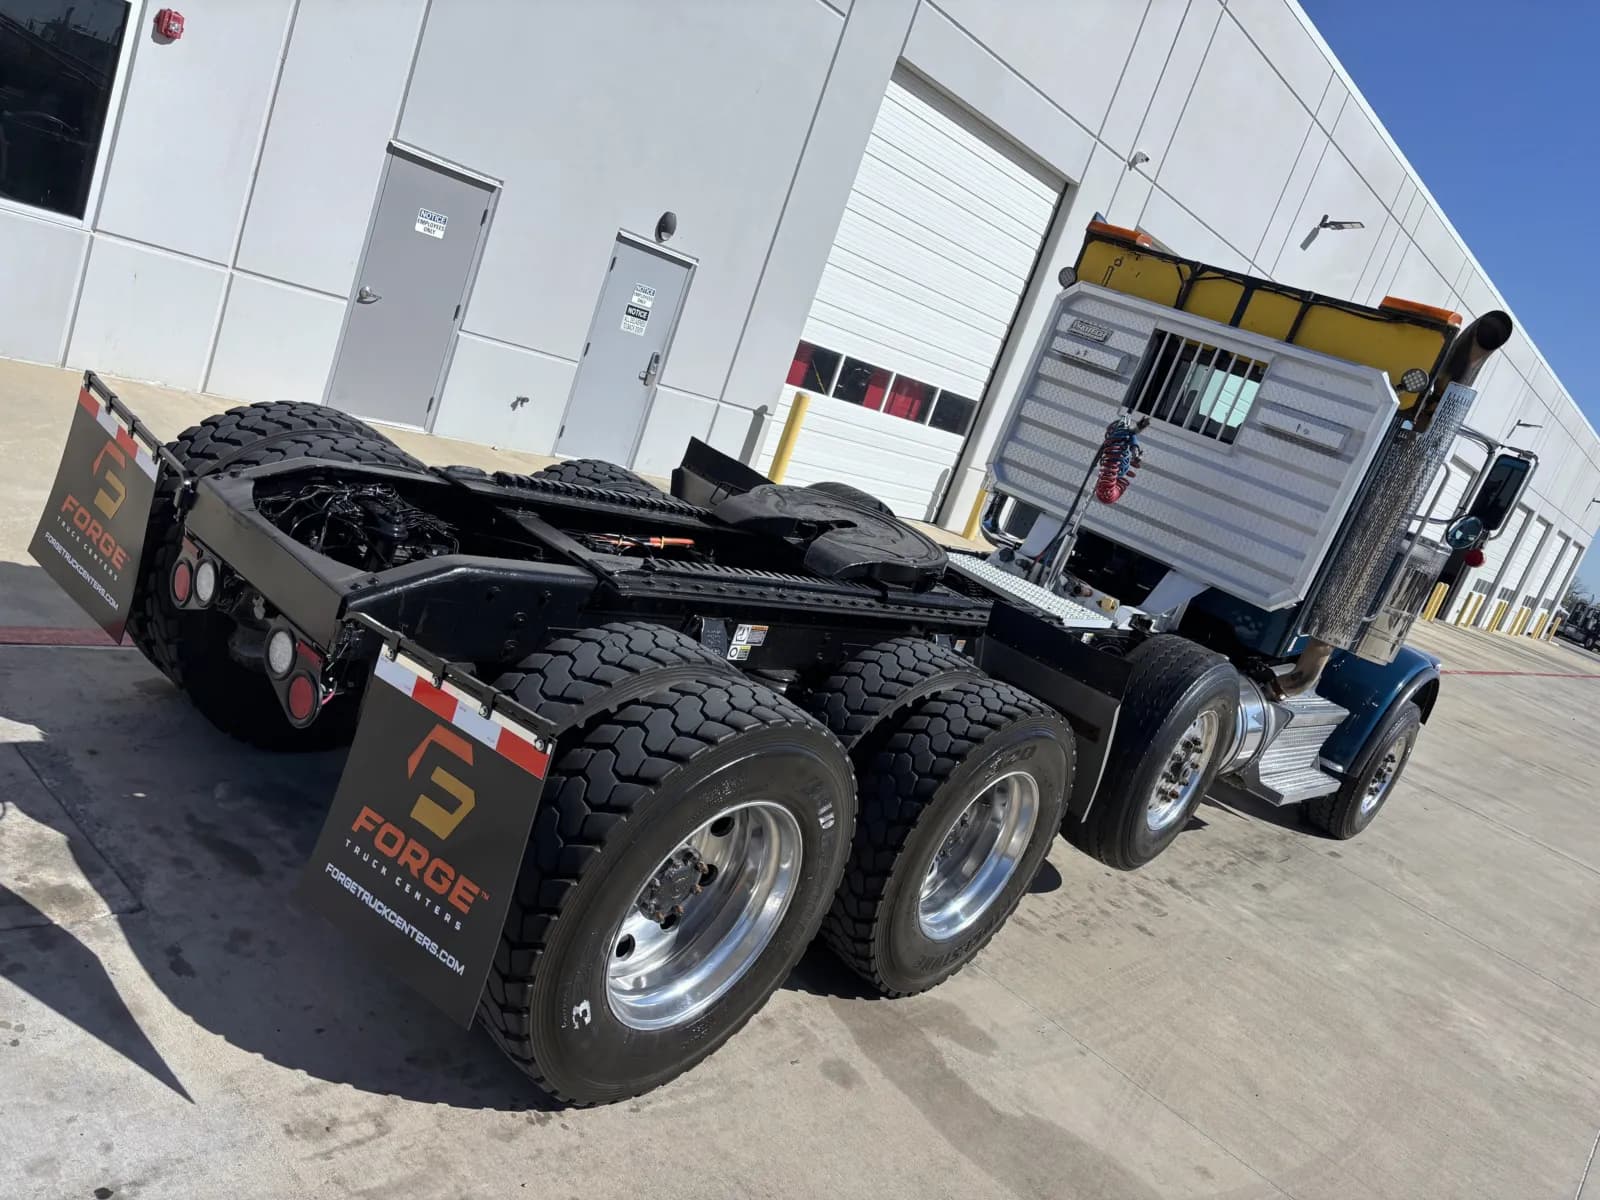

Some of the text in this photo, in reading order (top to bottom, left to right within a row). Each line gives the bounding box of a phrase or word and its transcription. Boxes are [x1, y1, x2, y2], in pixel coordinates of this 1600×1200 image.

[420, 209, 447, 225] NOTICE
[424, 227, 436, 235] ONLY
[628, 307, 648, 319] NOTICE
[45, 531, 119, 612] FORGETRUCKCENTERS.COM
[56, 515, 119, 582] TRUCK CENTERS
[61, 494, 128, 572] FORGE
[344, 839, 462, 931] TRUCK CENTERS
[351, 805, 481, 915] FORGE
[325, 862, 465, 976] FORGETRUCKCENTERS.COM
